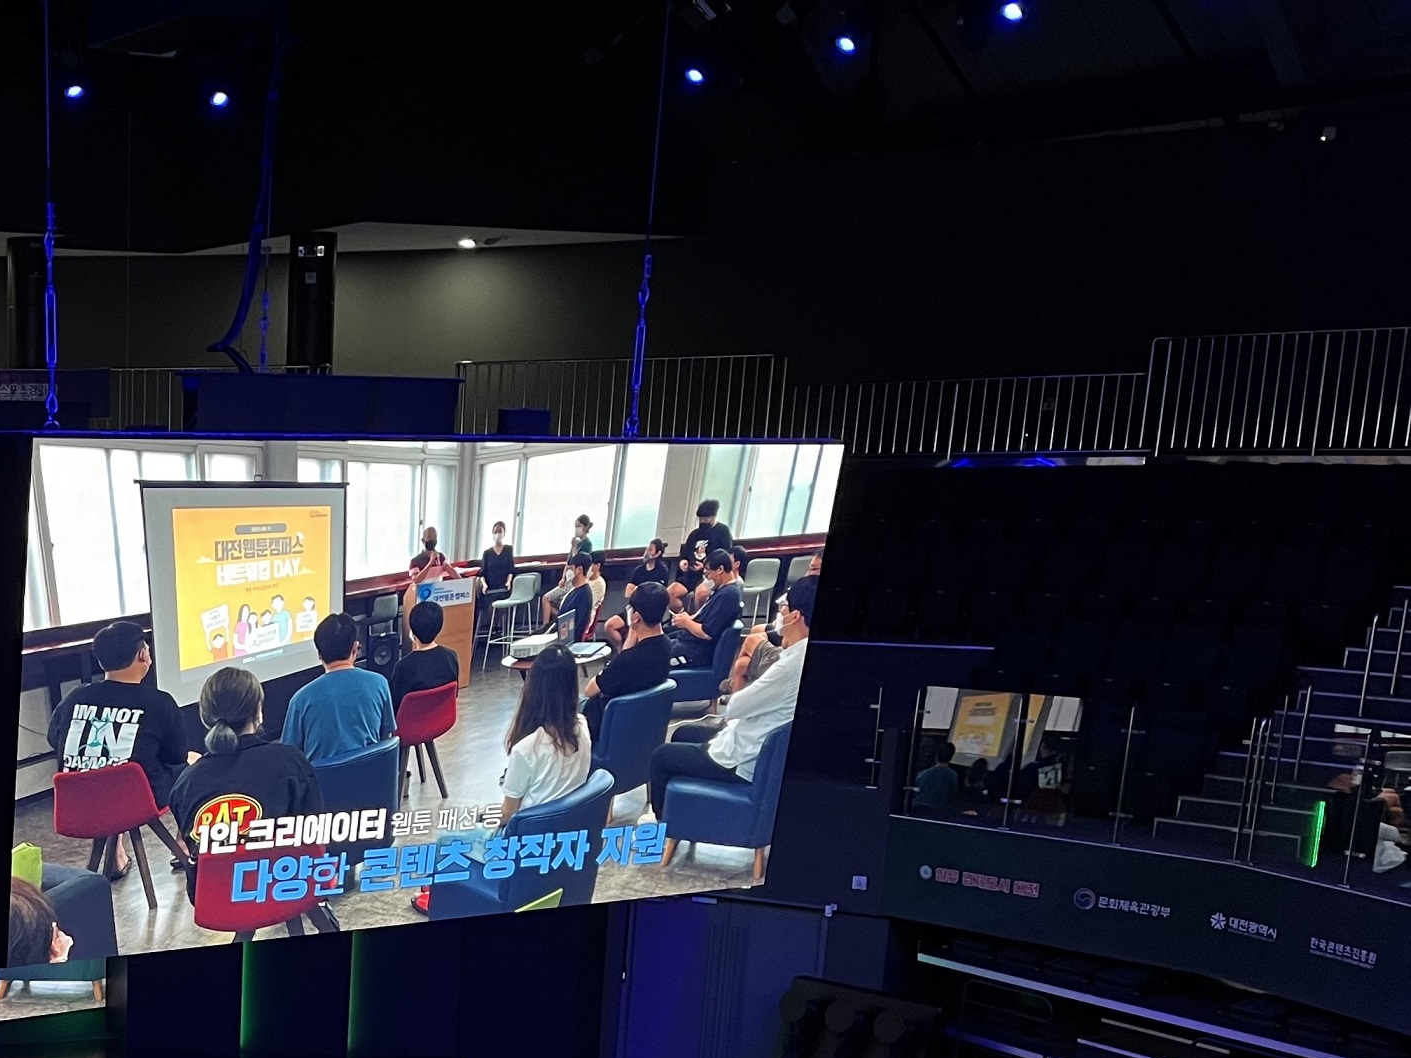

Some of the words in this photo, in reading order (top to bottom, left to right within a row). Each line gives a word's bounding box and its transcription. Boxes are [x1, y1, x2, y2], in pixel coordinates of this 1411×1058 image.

[273, 558, 301, 579] DAY
[72, 703, 97, 720] IM
[101, 706, 144, 723] NOT
[63, 720, 139, 758] IN
[198, 820, 239, 855] 1인
[245, 808, 387, 851] 크리에이터
[391, 808, 433, 837] 웹툰
[437, 809, 478, 832] 패션
[482, 804, 503, 829] 등
[231, 851, 351, 903] 다양한
[360, 839, 471, 893] 콘텐츠
[482, 829, 591, 879] 창작자
[596, 822, 668, 866] 지원
[1099, 895, 1171, 919] 문화체육관광부
[1228, 916, 1278, 940] 대전광역시
[1310, 936, 1378, 964] 한국콘텐츠진흥원
